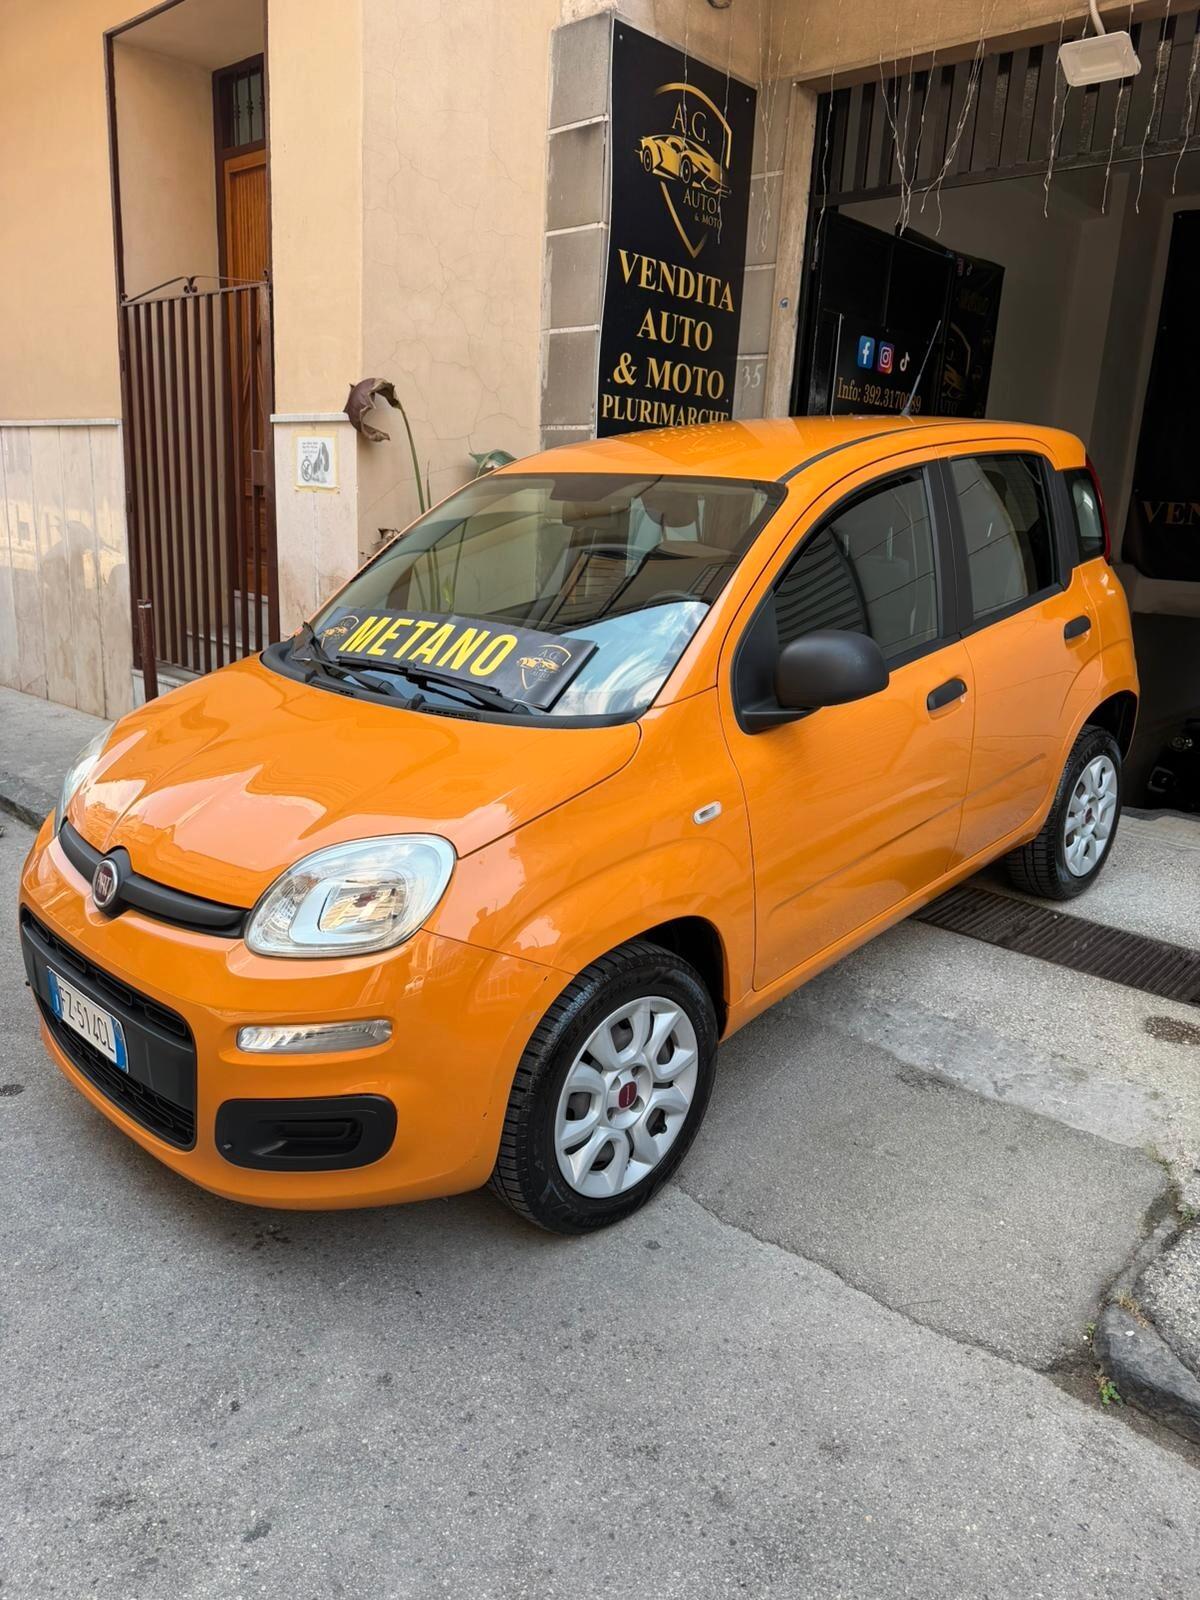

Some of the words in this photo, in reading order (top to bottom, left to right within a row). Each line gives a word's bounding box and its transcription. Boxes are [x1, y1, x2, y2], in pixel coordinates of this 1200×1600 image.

[618, 248, 735, 313] VENDITA
[636, 307, 713, 352] AUTO
[612, 352, 638, 387] &
[645, 356, 725, 400] MOTO
[836, 376, 862, 402] Info:
[338, 616, 518, 677] METANO
